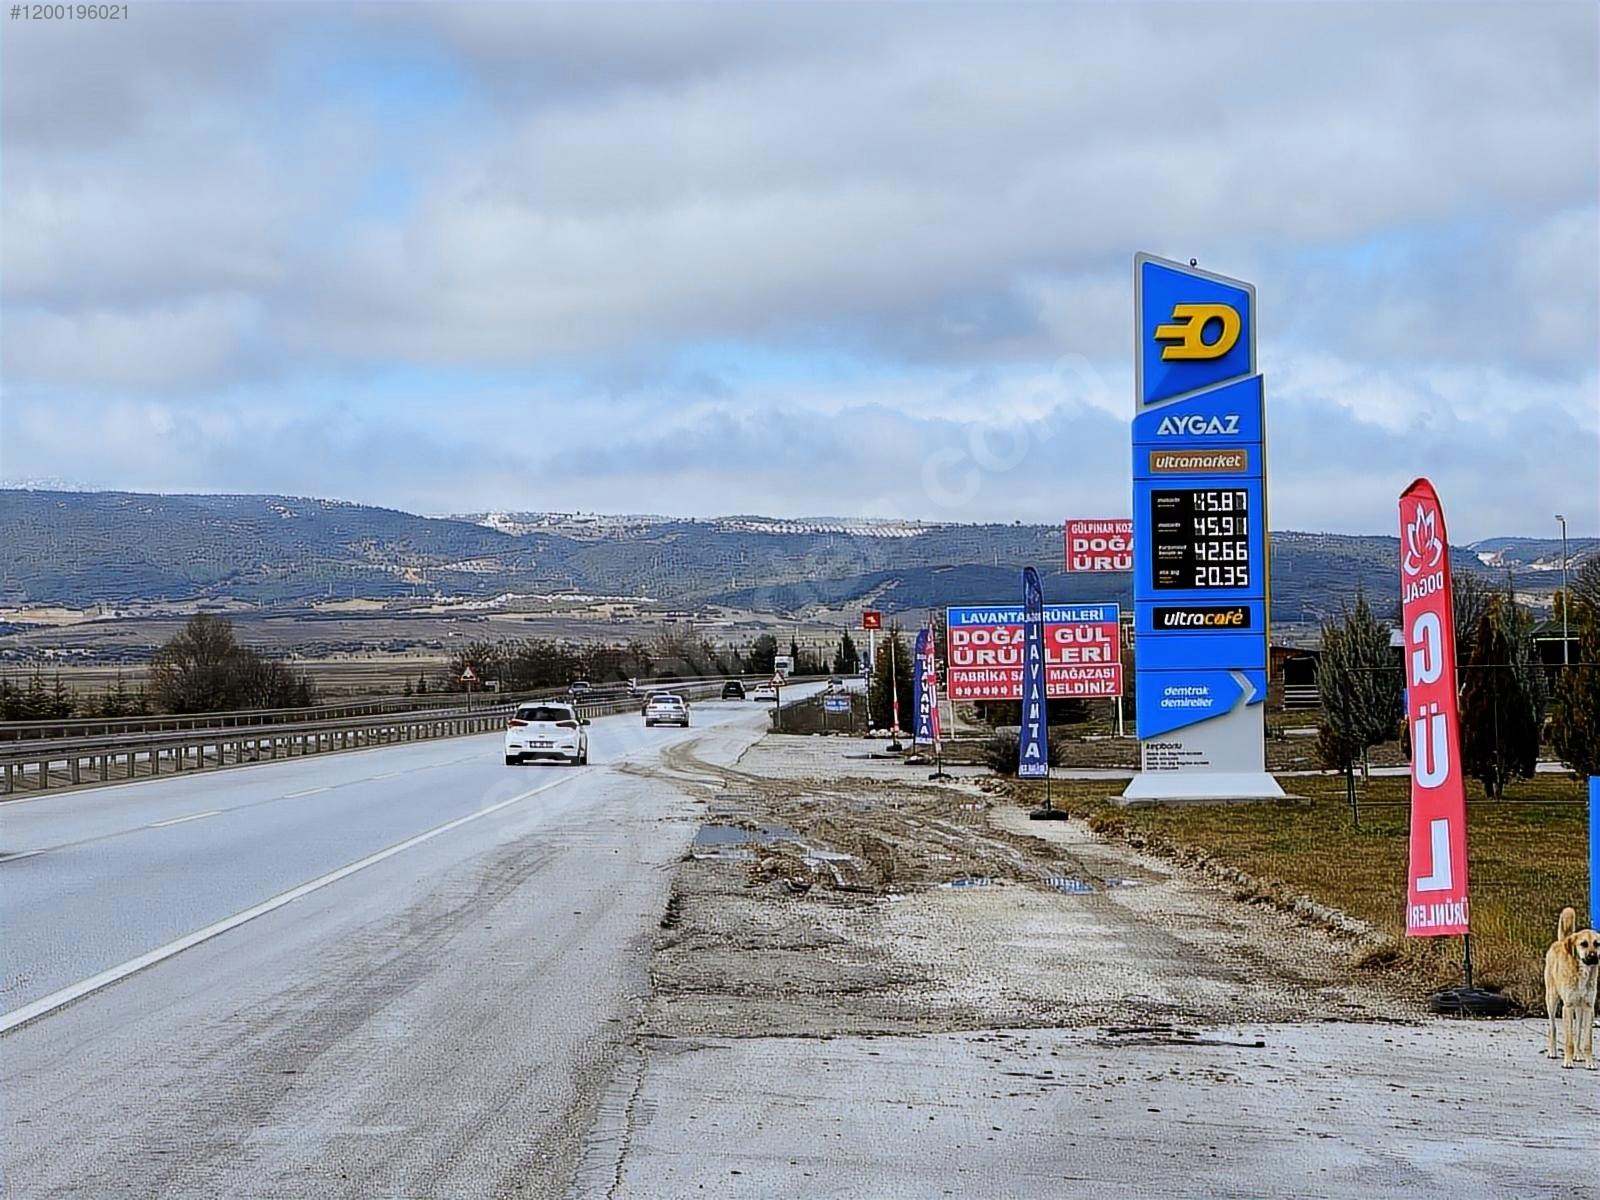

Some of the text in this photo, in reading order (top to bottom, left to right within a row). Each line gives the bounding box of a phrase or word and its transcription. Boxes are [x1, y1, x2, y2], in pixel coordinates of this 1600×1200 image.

[1157, 415, 1240, 435] AYGAZ
[1155, 454, 1241, 469] ultramarket
[1194, 517, 1247, 536] 45.91
[1194, 542, 1248, 561] 42.66
[1195, 566, 1248, 586] 20.35
[1043, 607, 1104, 622] RÜNLERİ
[1164, 609, 1243, 626] ultracafé
[1054, 624, 1111, 643] GÜL
[953, 670, 1007, 682] FABRİKA
[1050, 668, 1115, 681] MAĞAZASI
[1046, 680, 1116, 695] GELDİNİZ
